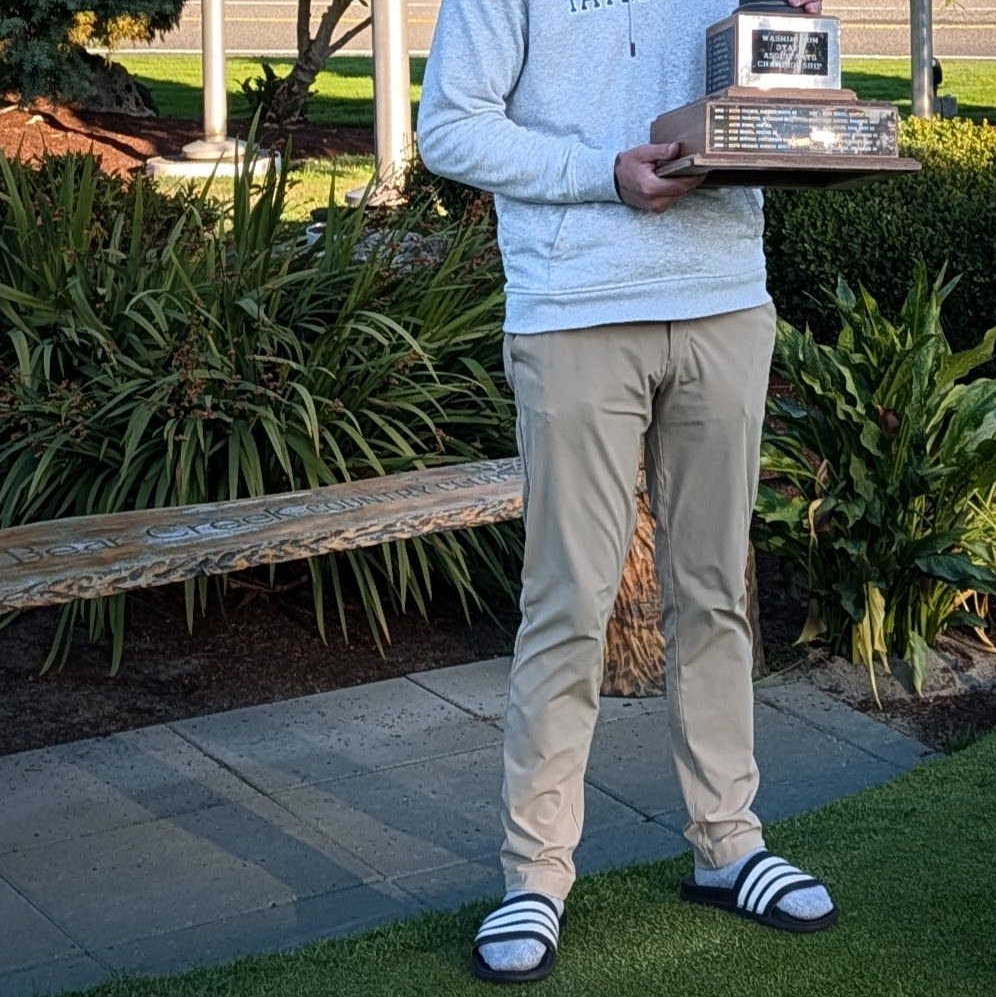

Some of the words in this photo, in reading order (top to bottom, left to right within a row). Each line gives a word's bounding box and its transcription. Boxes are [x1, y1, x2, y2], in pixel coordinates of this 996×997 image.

[761, 34, 819, 44] WASHINON
[763, 52, 818, 62] ASSISTTS
[145, 507, 299, 540] Creek
[306, 482, 432, 514] COUNTRY
